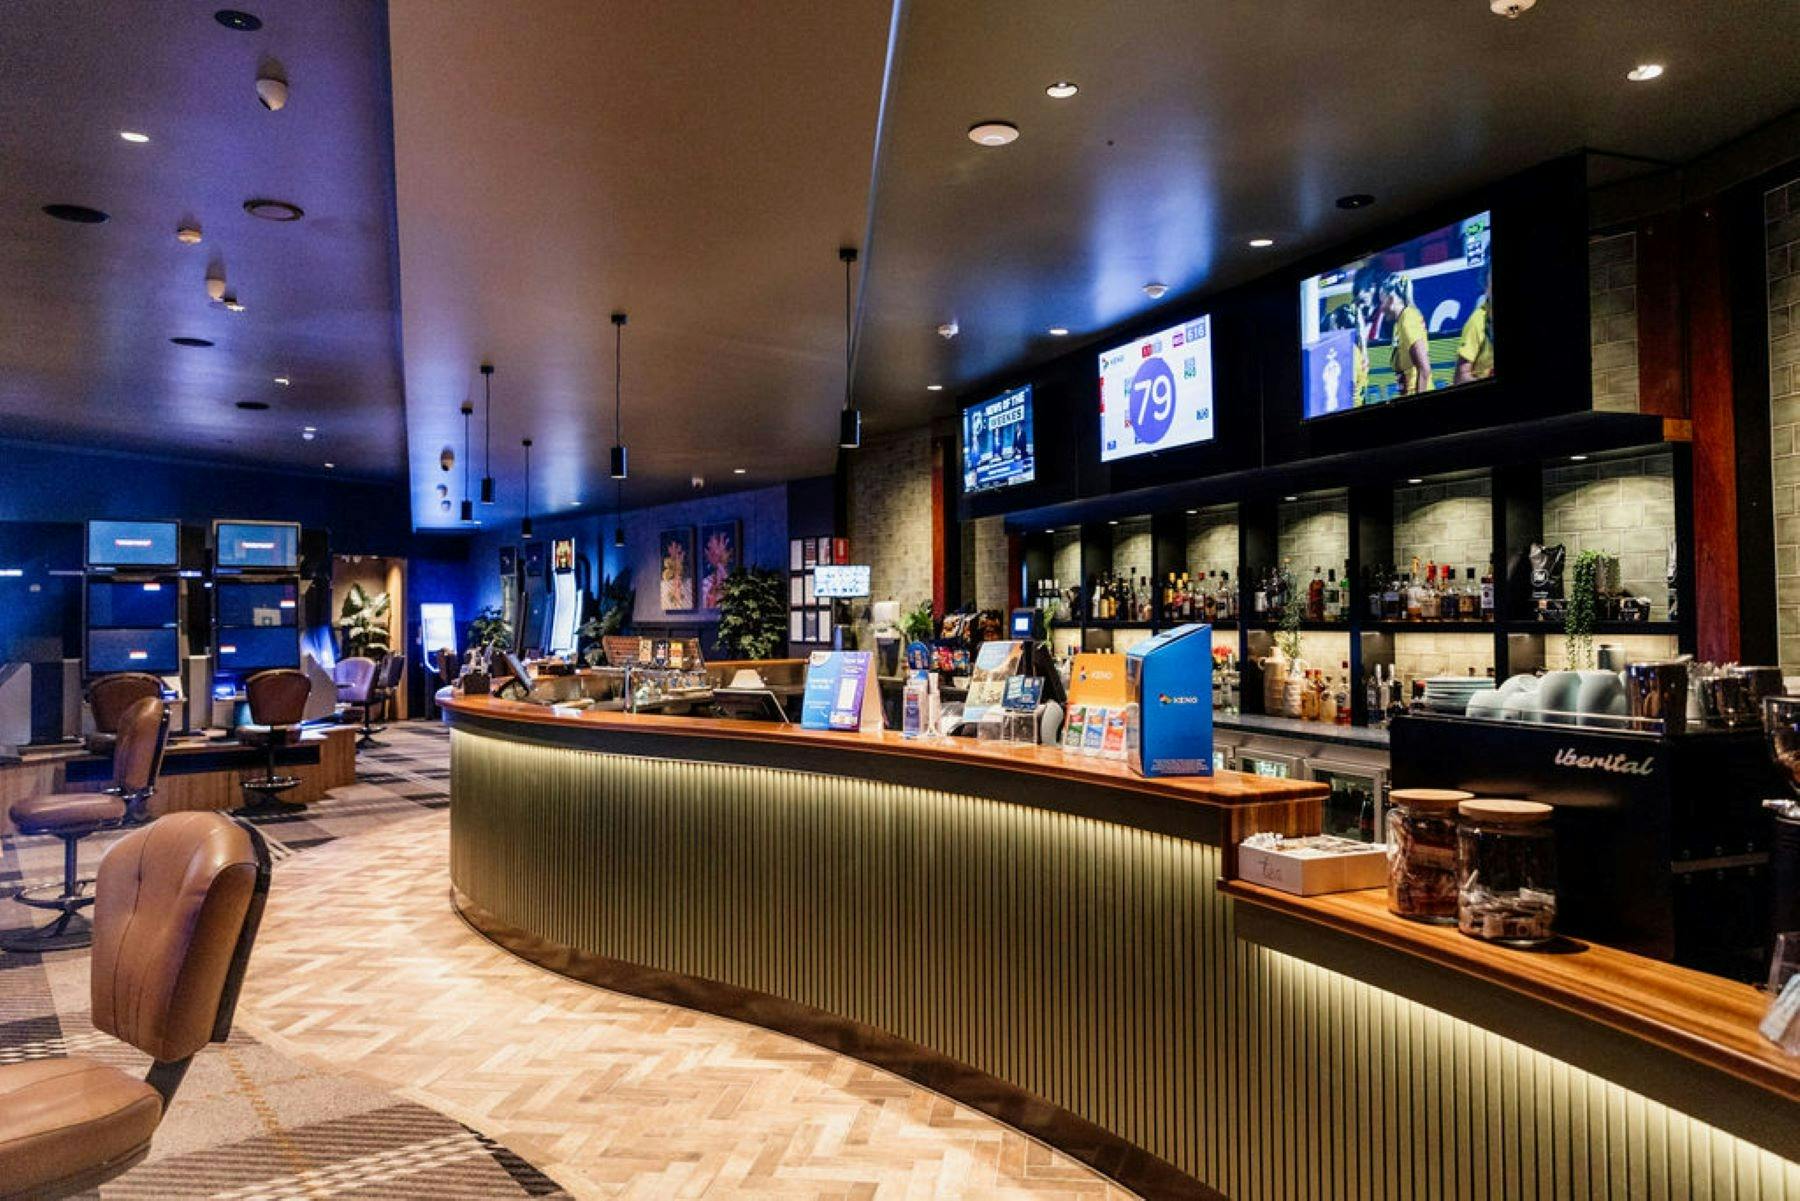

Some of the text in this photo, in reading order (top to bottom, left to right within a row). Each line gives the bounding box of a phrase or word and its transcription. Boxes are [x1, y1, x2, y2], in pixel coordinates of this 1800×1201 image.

[1134, 374, 1172, 425] 79
[1091, 671, 1112, 680] KENO
[1173, 696, 1198, 704] KENO
